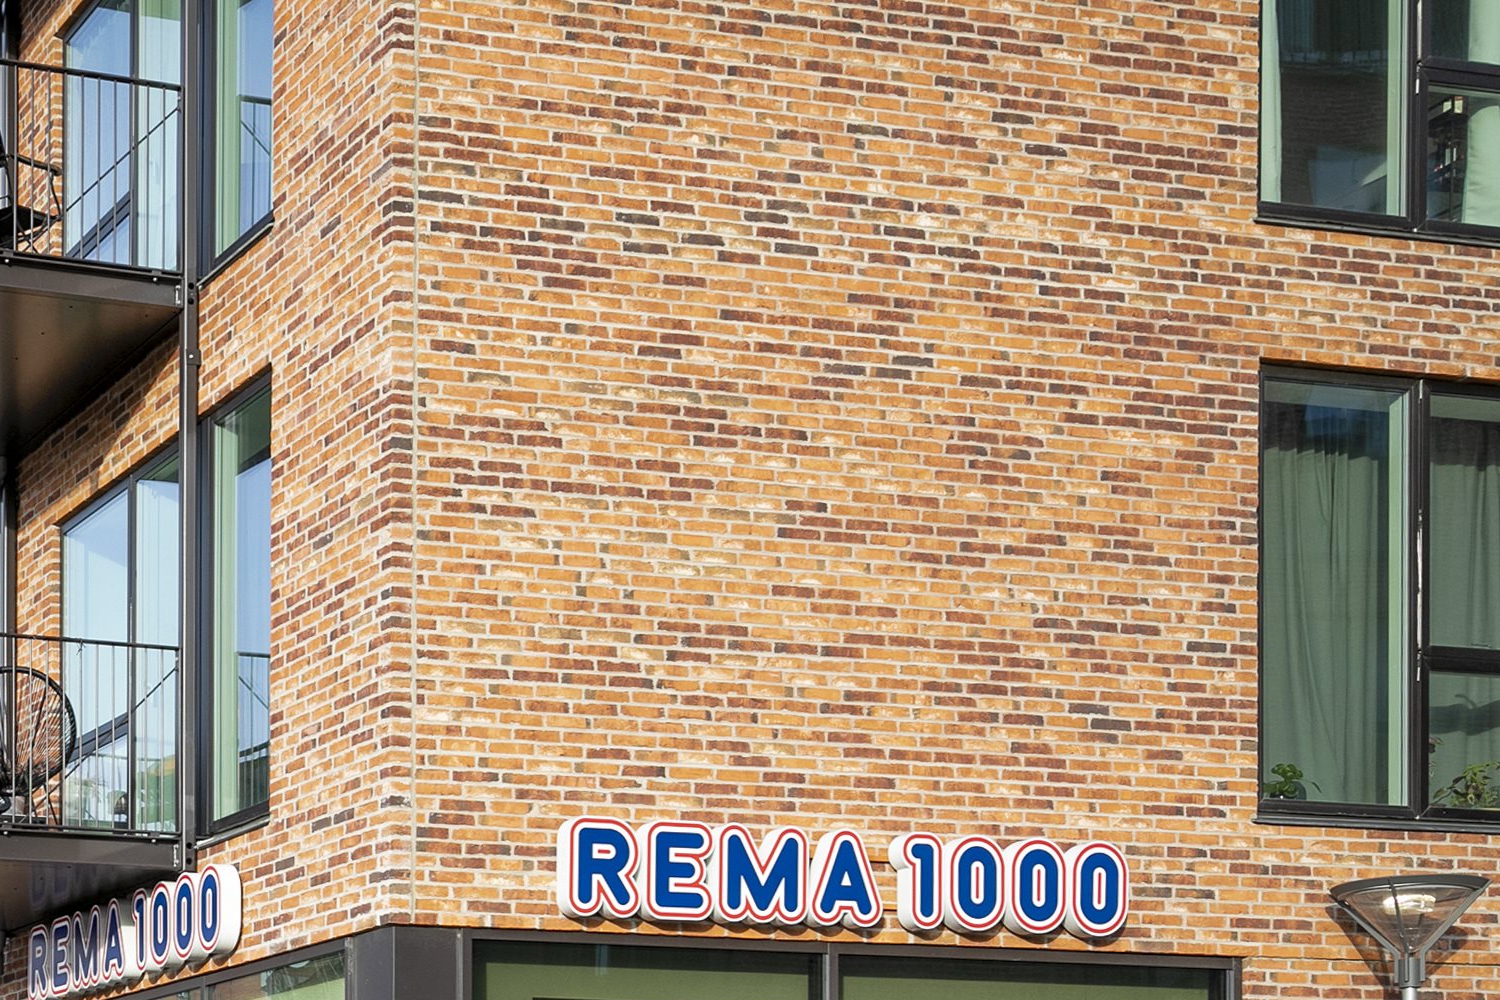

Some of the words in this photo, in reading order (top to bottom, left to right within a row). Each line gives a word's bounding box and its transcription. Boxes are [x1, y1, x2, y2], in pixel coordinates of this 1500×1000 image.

[29, 898, 125, 1000] REMA
[133, 865, 221, 970] 1000
[570, 817, 882, 926] REMA
[901, 832, 1128, 936] 1000
